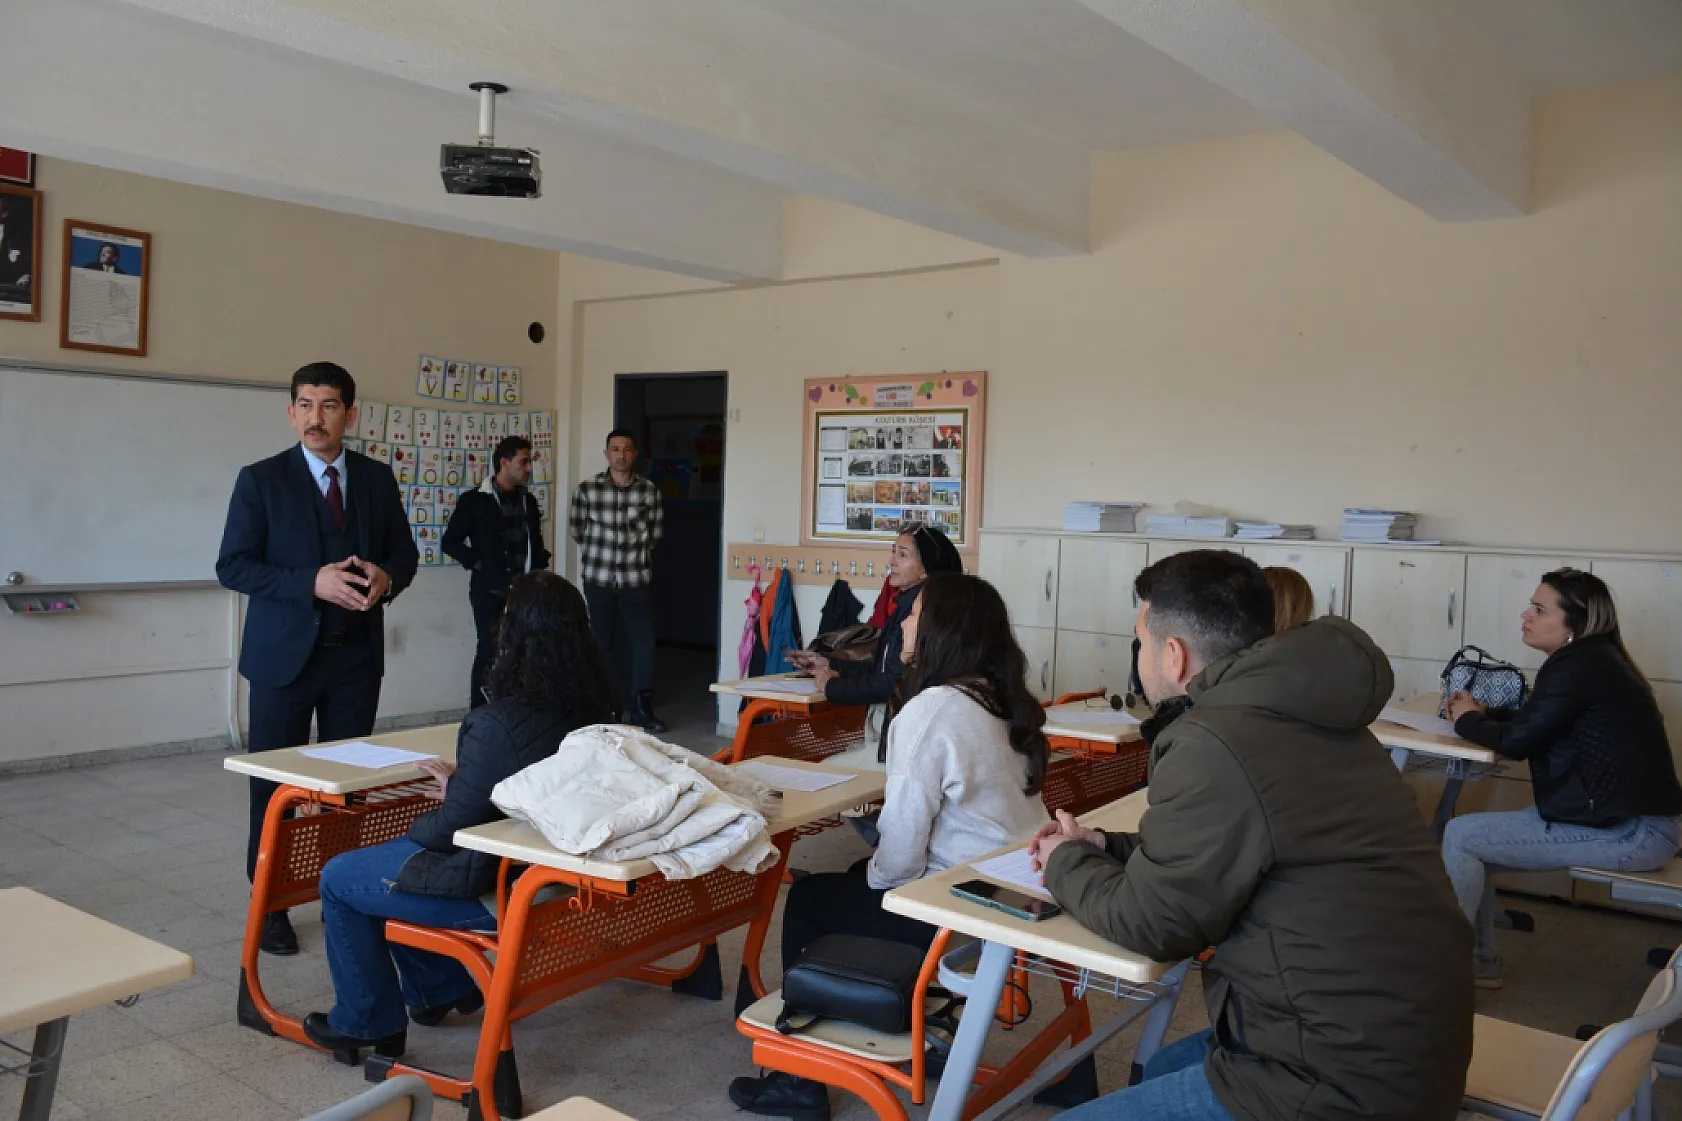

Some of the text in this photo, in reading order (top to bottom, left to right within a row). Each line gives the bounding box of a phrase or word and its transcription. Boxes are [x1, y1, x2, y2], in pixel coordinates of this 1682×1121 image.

[426, 379, 438, 395] V
[453, 383, 462, 399] F
[481, 387, 490, 403] J
[369, 406, 374, 419] 1
[393, 409, 403, 424] 2
[419, 412, 427, 426] 3
[443, 416, 452, 429] 4
[466, 416, 475, 429] 5
[489, 417, 498, 429] 6
[512, 416, 519, 429] 7
[535, 415, 542, 428] 8
[875, 416, 907, 425] ATATÜRK
[401, 466, 410, 483] E
[424, 468, 437, 485] O
[416, 507, 427, 523] D
[424, 547, 434, 564] B
